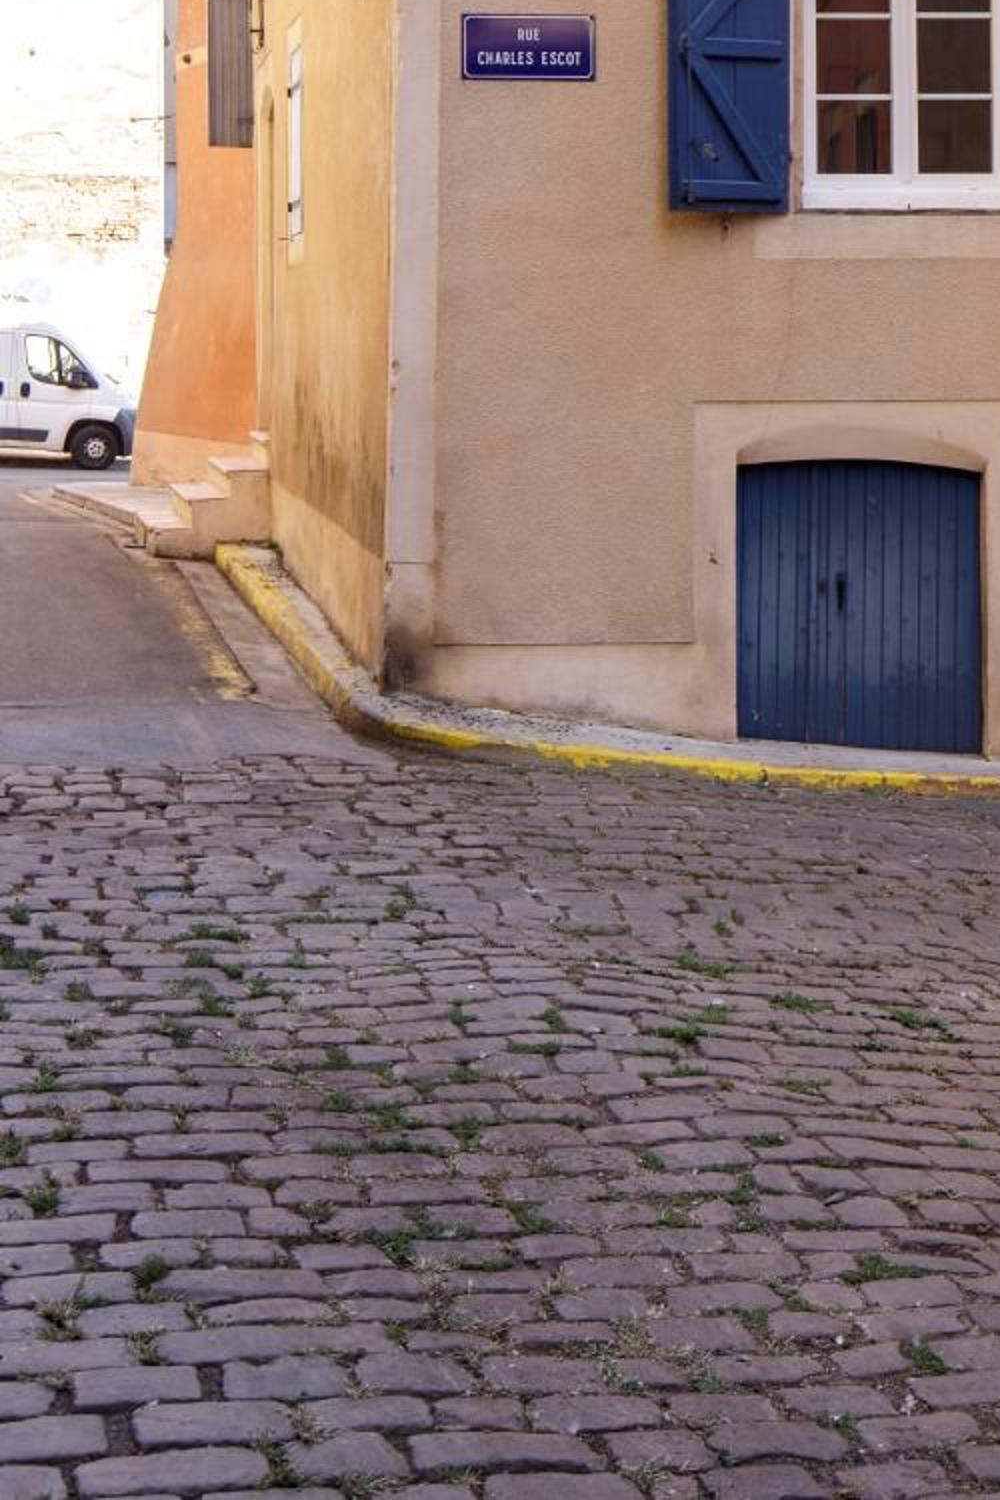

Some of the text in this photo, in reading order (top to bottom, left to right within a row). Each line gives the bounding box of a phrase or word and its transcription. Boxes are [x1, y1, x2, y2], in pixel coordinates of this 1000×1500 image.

[517, 27, 541, 41] RUE
[477, 51, 582, 66] CHARLES ESCOT
